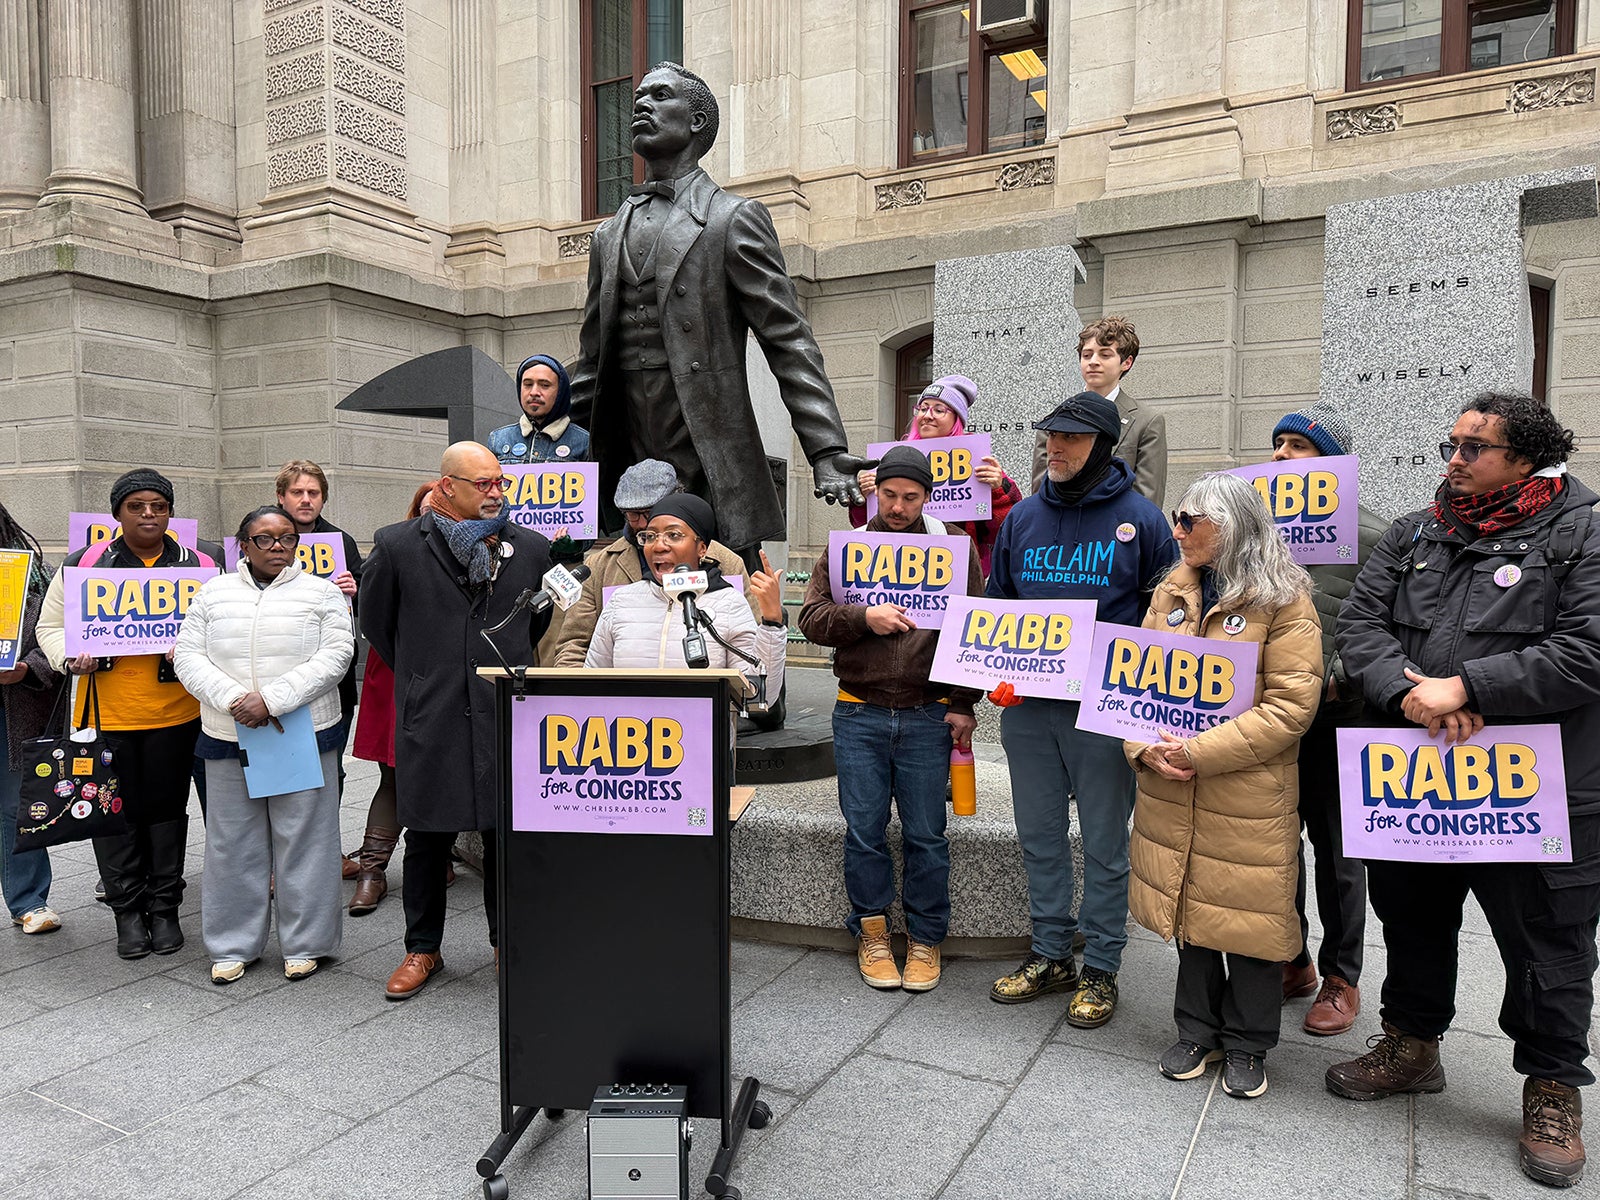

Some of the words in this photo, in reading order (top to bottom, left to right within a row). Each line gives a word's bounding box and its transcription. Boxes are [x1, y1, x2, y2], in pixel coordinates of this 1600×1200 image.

[1366, 277, 1469, 298] SEEMS
[971, 327, 1026, 340] THAT
[1357, 364, 1472, 382] WISELY
[927, 448, 973, 487] BB
[1392, 455, 1426, 466] TO
[929, 487, 972, 502] GRESS
[514, 510, 584, 525] CONGRESS
[842, 541, 954, 592] RABB
[1023, 540, 1116, 575] RECLAIM
[671, 577, 685, 586] 10
[1021, 571, 1110, 587] PHILADELPHIA
[843, 590, 864, 605] for
[866, 591, 949, 611] CONGRESS
[82, 624, 111, 640] for
[113, 622, 181, 640] CONGR
[959, 609, 1073, 656] RABB
[956, 650, 982, 664] for
[983, 654, 1066, 675] CONGRESS
[1101, 637, 1235, 710] RABB
[1097, 693, 1127, 712] for
[539, 714, 685, 777] RABB
[736, 759, 785, 772] CATTO
[1360, 742, 1541, 811] RABB
[540, 778, 572, 799] for
[575, 778, 682, 801] CONGRESS
[553, 804, 667, 814] WWW.CHRISRABB.COM
[1365, 810, 1402, 833] for
[1405, 812, 1542, 836] CONGRESS
[1392, 838, 1514, 847] WWW.CHRISRABB.COM
